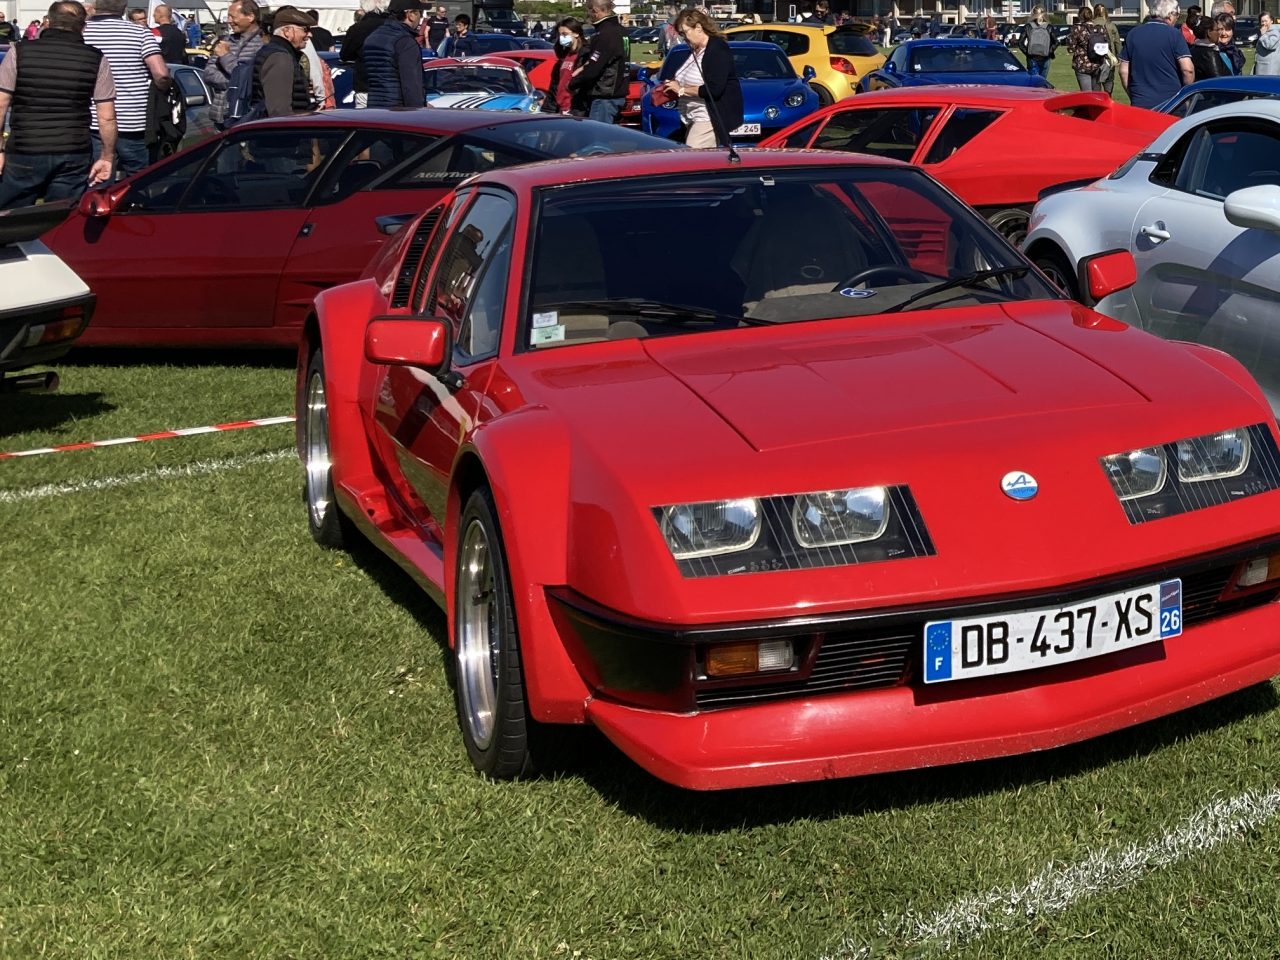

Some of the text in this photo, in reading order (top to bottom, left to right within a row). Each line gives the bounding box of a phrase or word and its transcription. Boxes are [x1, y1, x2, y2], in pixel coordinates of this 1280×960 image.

[961, 593, 1153, 669] DB-437-XS
[1161, 609, 1180, 632] 26
[934, 657, 943, 671] F
